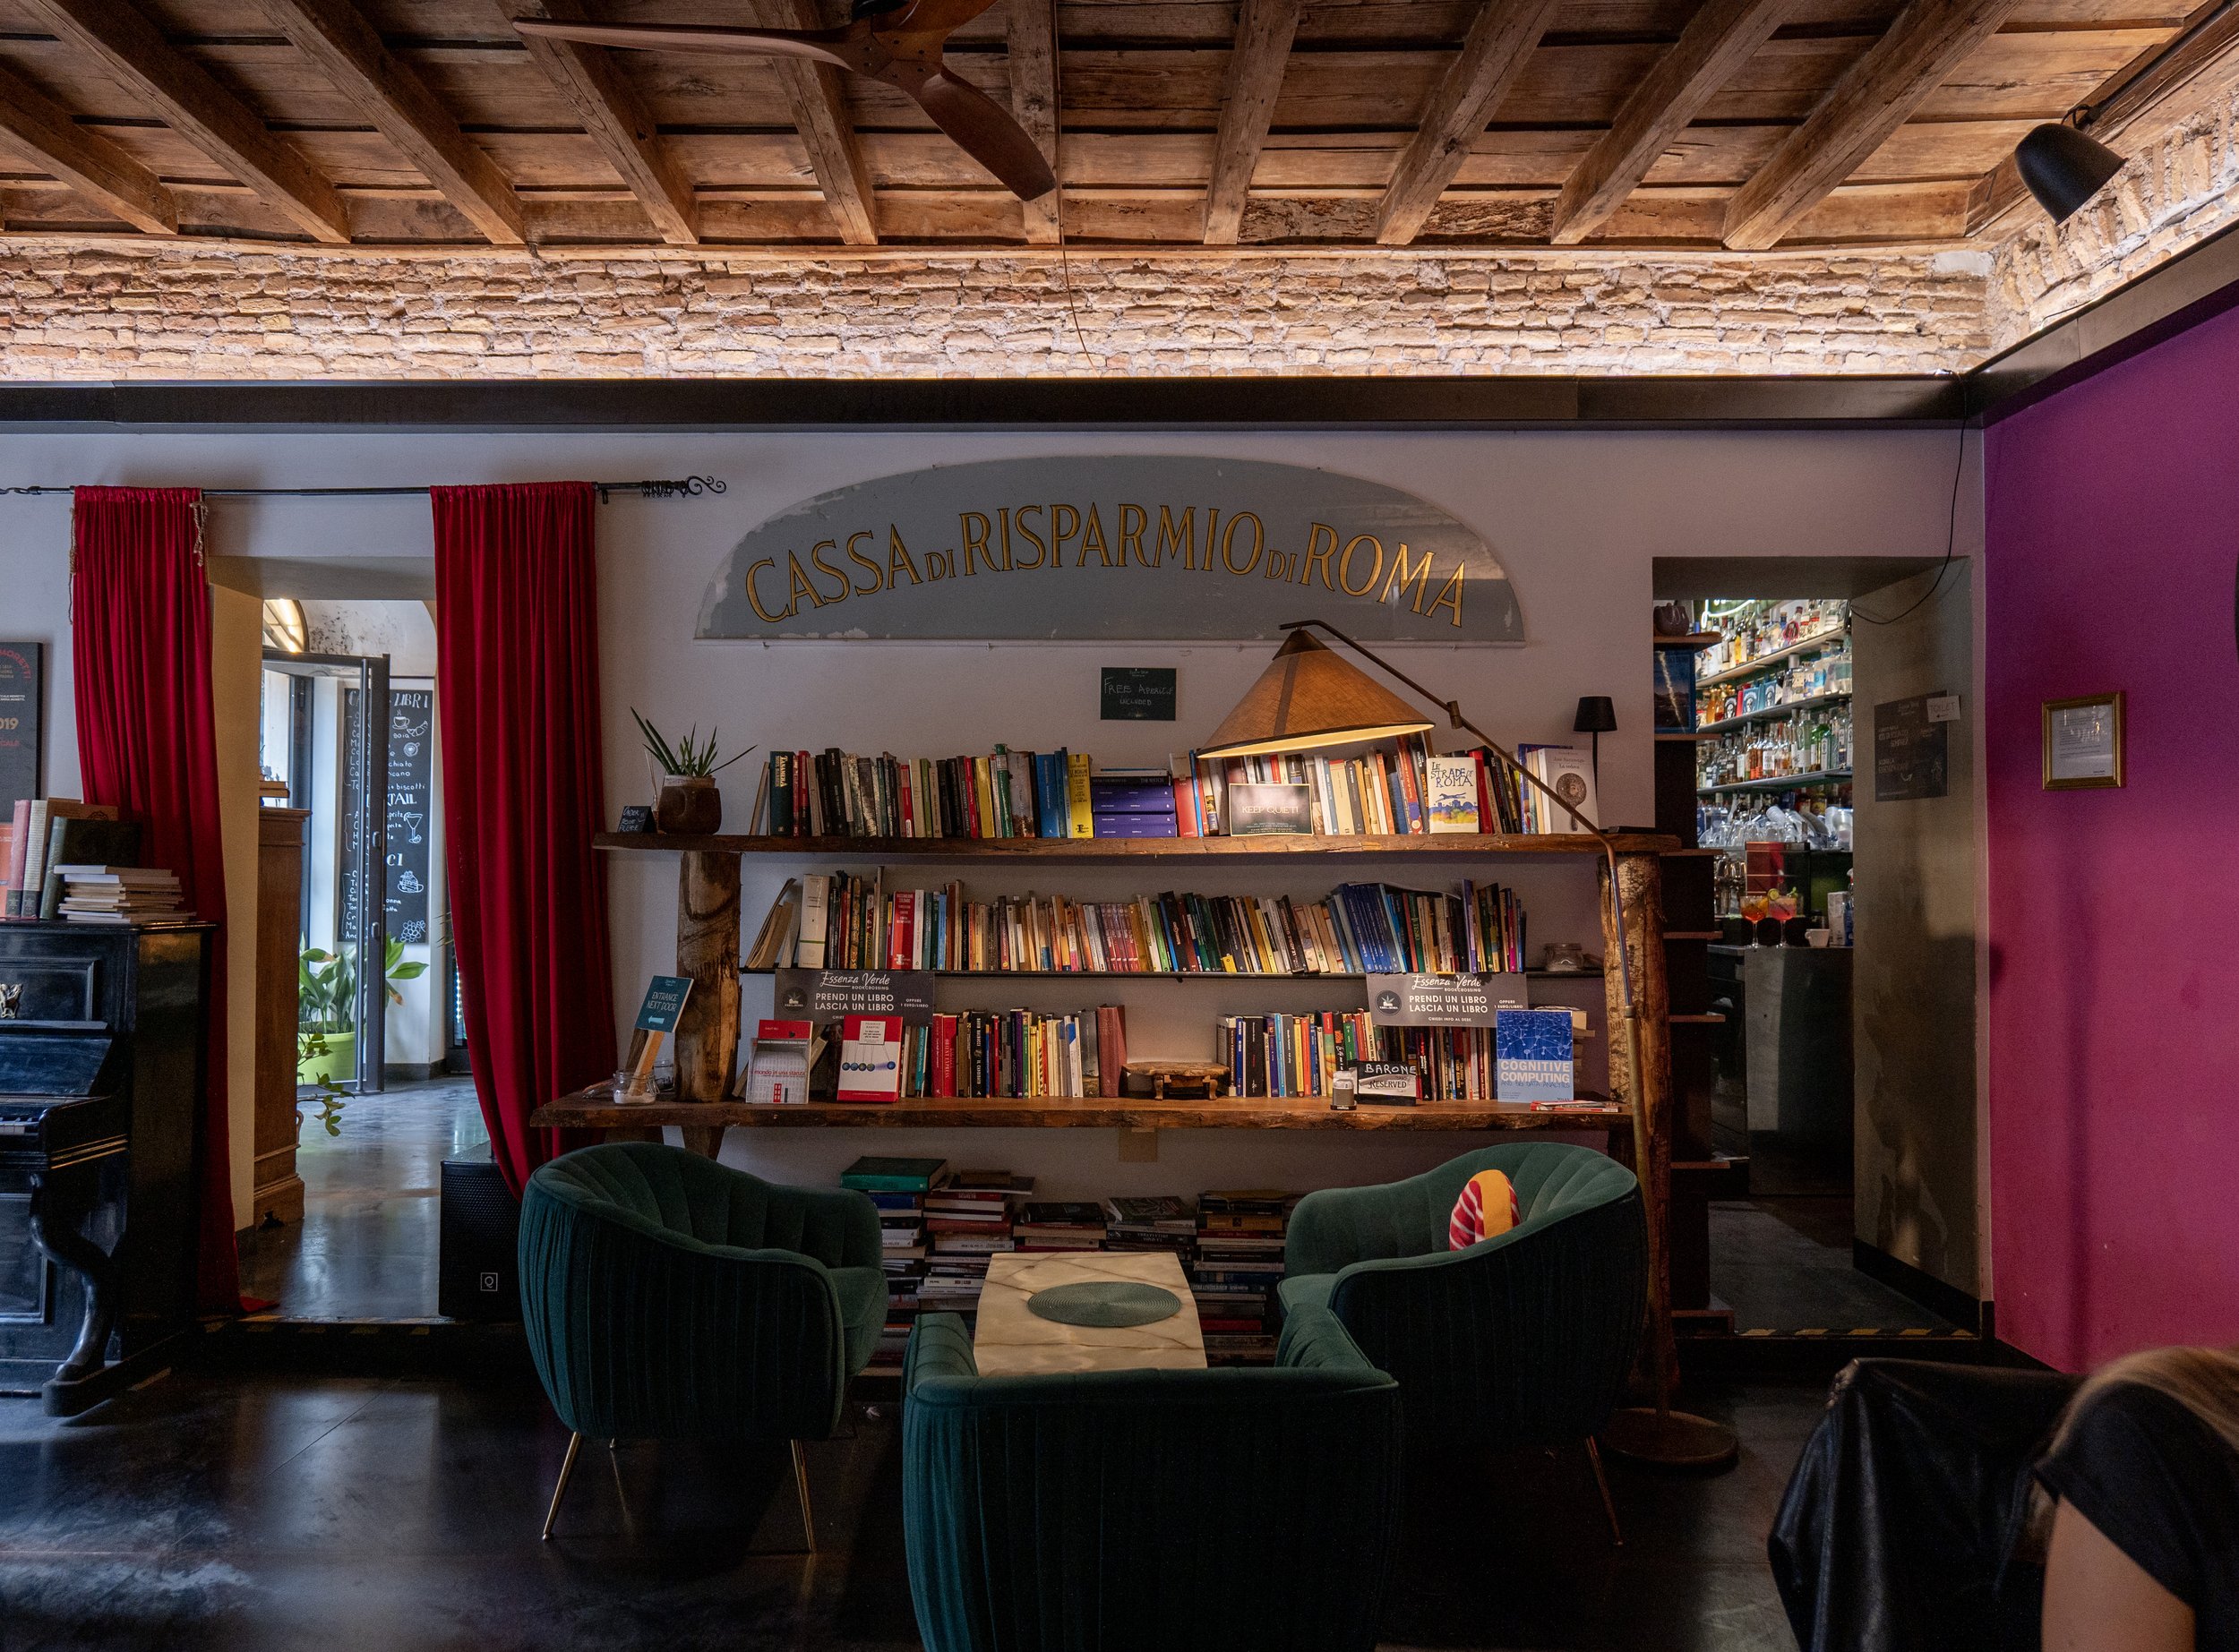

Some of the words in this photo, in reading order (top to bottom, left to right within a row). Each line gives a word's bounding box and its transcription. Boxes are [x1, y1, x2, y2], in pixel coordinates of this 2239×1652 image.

[745, 523, 923, 623] CASSA
[924, 549, 954, 581] DI
[958, 501, 1265, 576] RISPARMIO
[1265, 549, 1298, 583] DI
[1299, 522, 1466, 628] ROMA
[1431, 762, 1441, 771] LE
[1430, 768, 1466, 779] STRADE
[1436, 776, 1474, 788] ROMA
[1242, 806, 1264, 814] KEEP
[819, 971, 859, 987] Essenza
[862, 972, 890, 986] Verde
[1411, 974, 1451, 989] Essenza
[1454, 974, 1482, 989] Verde
[651, 991, 678, 1002] ENTRANCE
[815, 993, 848, 1001] PRENDI
[852, 993, 866, 1001] UN
[867, 994, 894, 1002] LIBRO
[1409, 995, 1442, 1003] PRENDI
[1461, 996, 1487, 1004] LIBRO
[647, 1000, 661, 1010] NEXT
[661, 1002, 677, 1012] DOOR
[815, 1002, 848, 1010] LASCIA
[852, 1003, 866, 1011] UN
[868, 1003, 895, 1012] LIBRO
[1410, 1004, 1443, 1012] LASCIA
[1446, 1005, 1460, 1013] UN
[1462, 1006, 1488, 1014] LIBRO
[1365, 1064, 1416, 1074] BARONE
[1500, 1060, 1570, 1072] COGNITIVE
[1500, 1072, 1570, 1083] COMPUTING
[1368, 1079, 1407, 1089] RESERVED
